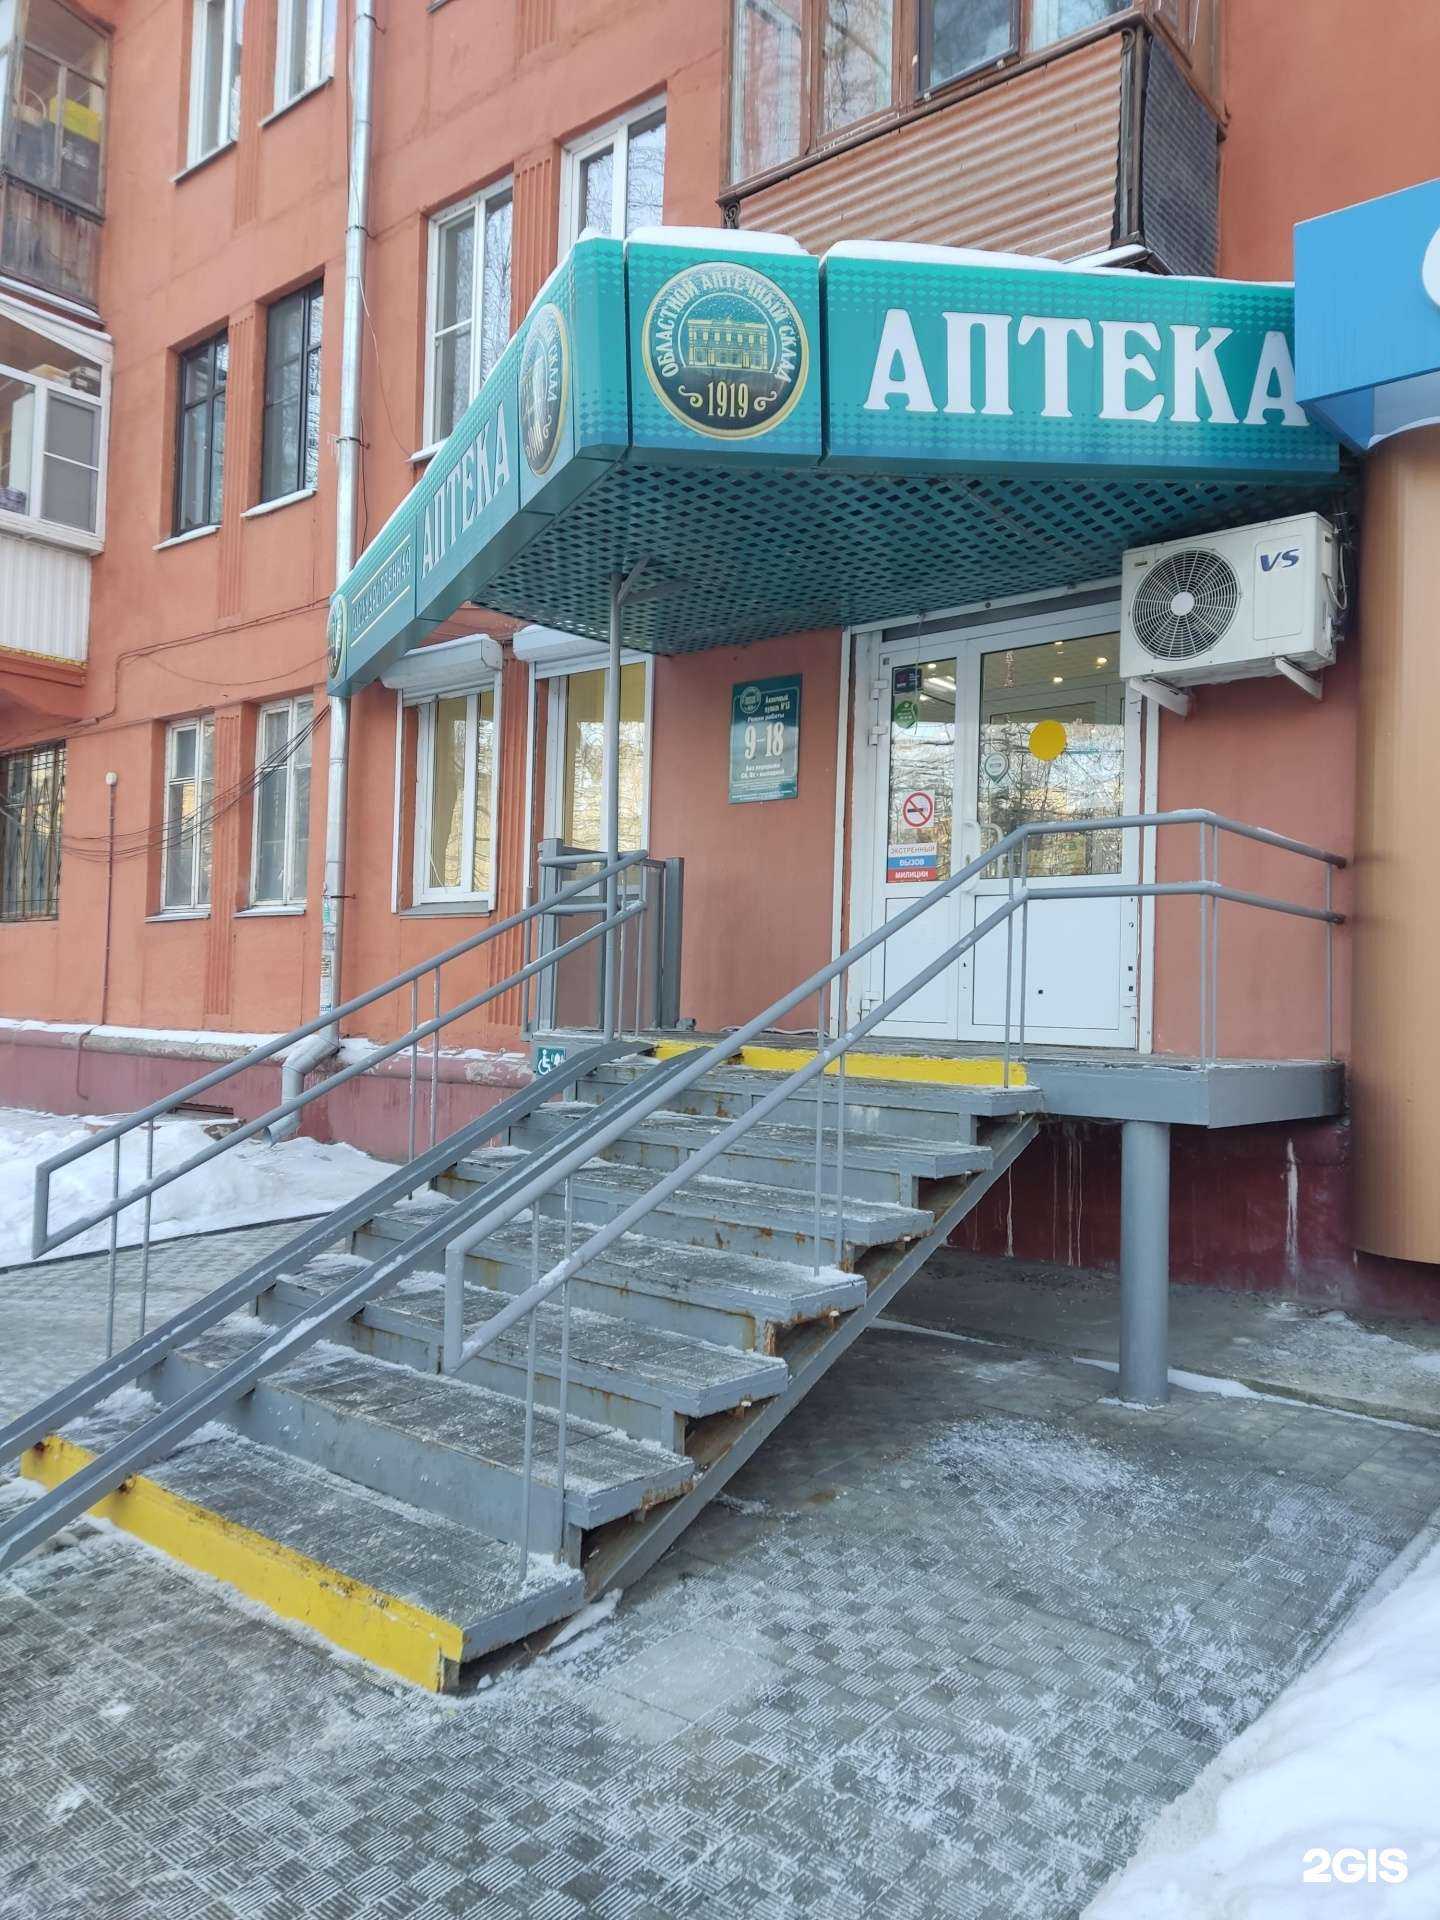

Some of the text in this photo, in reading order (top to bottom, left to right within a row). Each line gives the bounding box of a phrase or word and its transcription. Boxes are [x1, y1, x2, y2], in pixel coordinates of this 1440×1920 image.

[657, 270, 797, 384] ОБЛАСТНОЙ АПТЕЧНЫЙ СКЛАД
[863, 308, 1310, 427] АПТЕКА
[706, 381, 749, 418] 1919
[421, 401, 510, 580] АПТЕКА
[1260, 549, 1300, 572] VS
